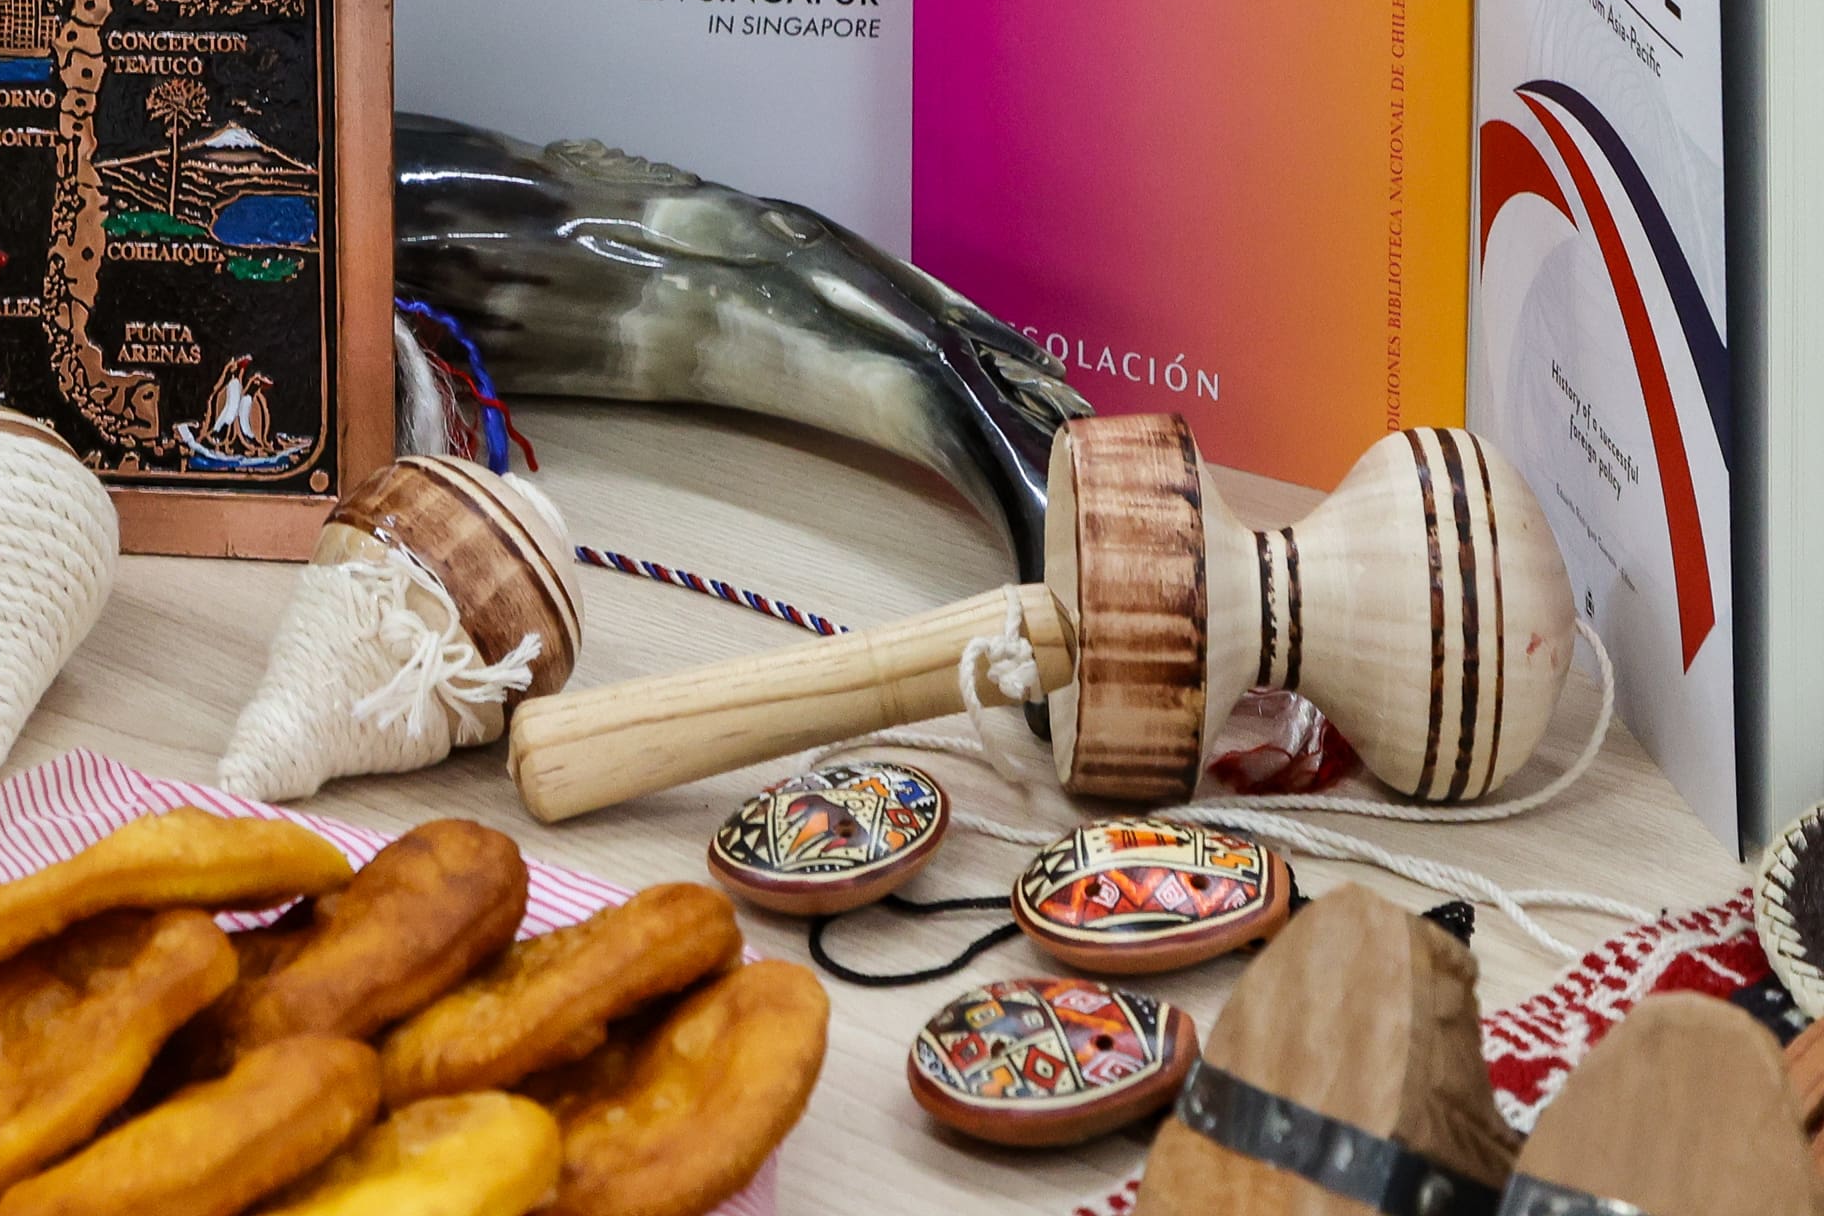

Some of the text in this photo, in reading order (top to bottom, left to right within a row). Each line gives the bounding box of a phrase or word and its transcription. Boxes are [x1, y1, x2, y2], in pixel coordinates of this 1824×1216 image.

[107, 30, 247, 53] CONCEPCION
[708, 14, 882, 39] IN SINGAPORE
[1607, 4, 1662, 78] Asia-Pacific
[111, 55, 202, 77] TEMUCO
[1391, 64, 1405, 92] DE
[1390, 97, 1405, 203] NACIONAL
[1388, 209, 1403, 329] BIBLIOTECA
[117, 344, 202, 364] ARENAS
[125, 321, 194, 342] PUNTA
[1008, 322, 1220, 401] SOLACIÓN
[1551, 359, 1580, 416] History
[1582, 404, 1592, 430] of
[1599, 427, 1639, 485] successful
[1569, 414, 1621, 501] foreign policy
